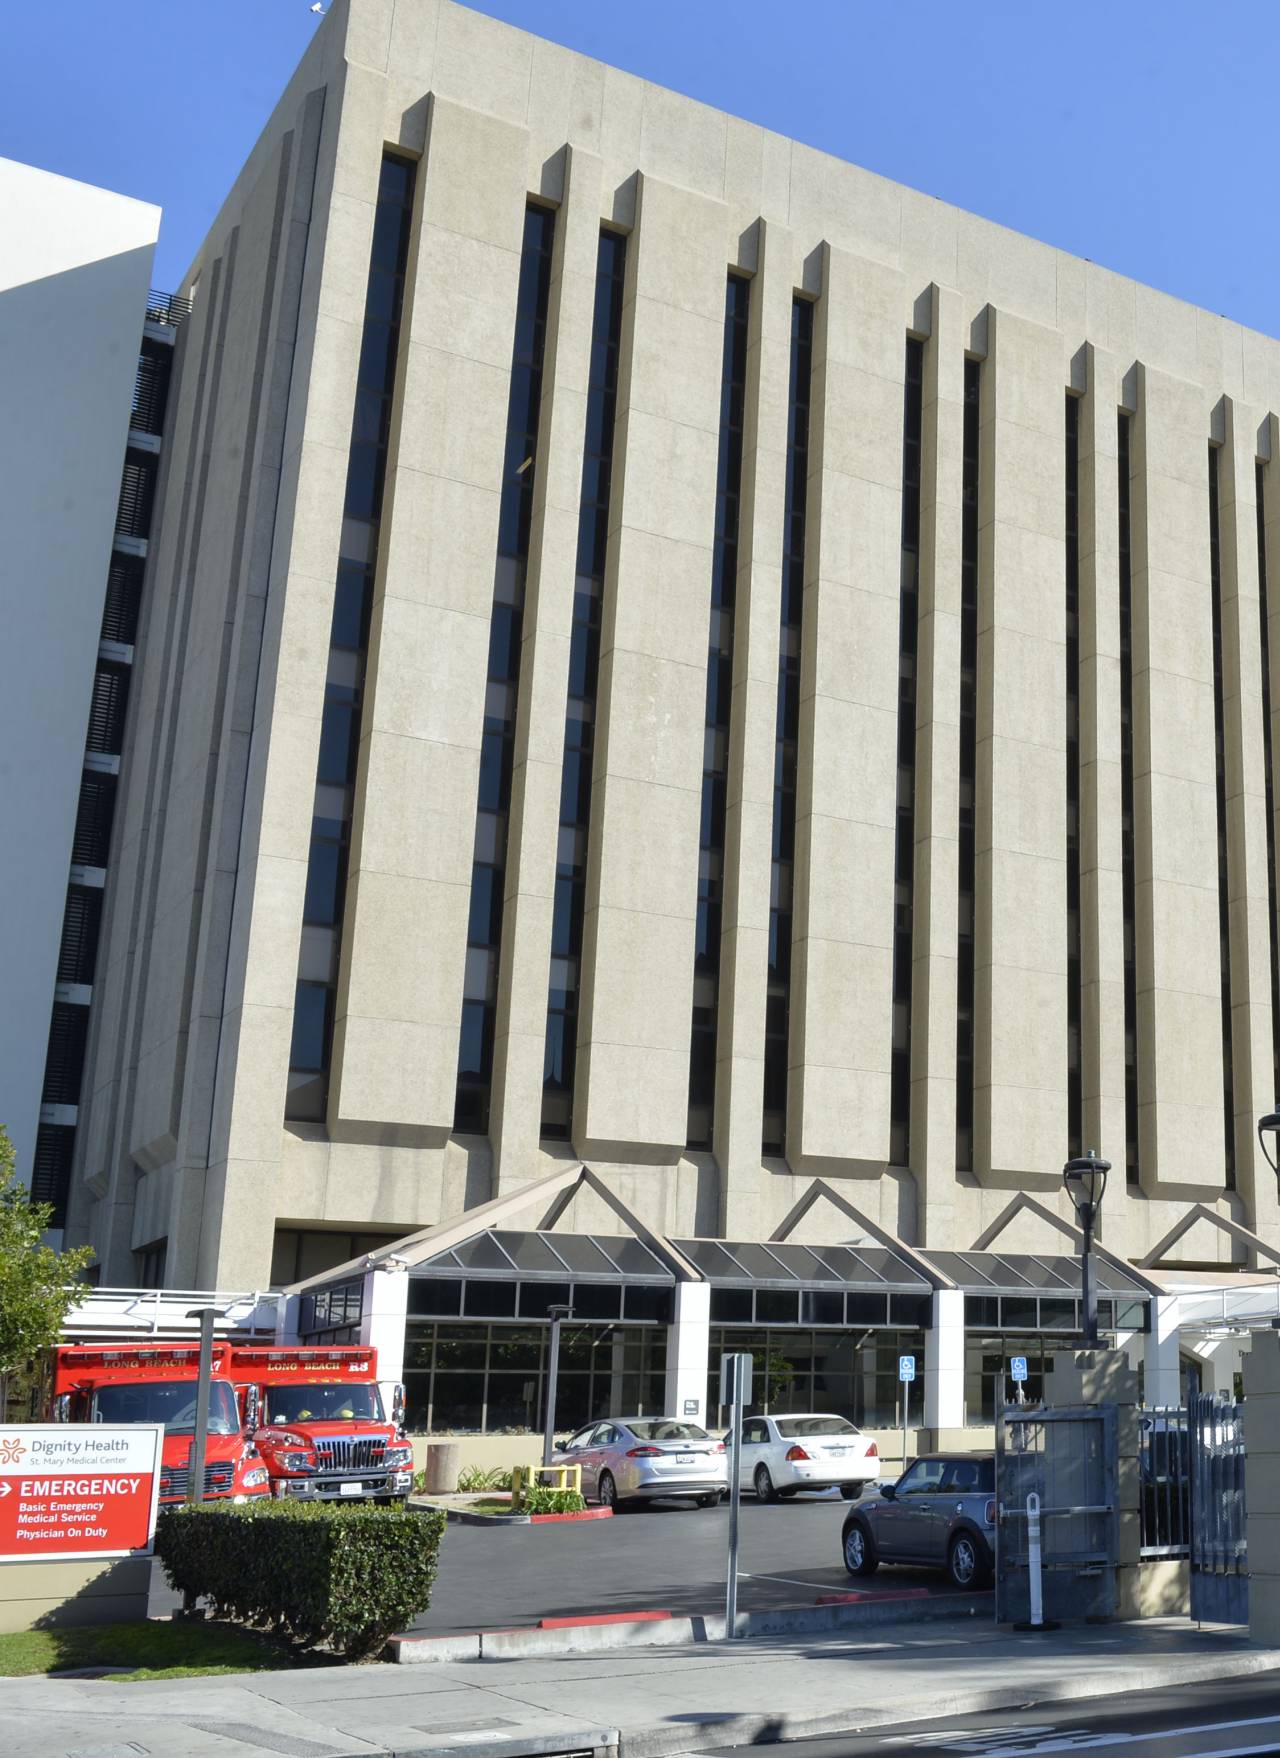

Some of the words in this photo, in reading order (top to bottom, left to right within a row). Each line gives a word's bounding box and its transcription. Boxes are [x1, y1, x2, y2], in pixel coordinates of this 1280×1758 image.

[103, 1360, 139, 1368] LONG
[267, 1363, 297, 1371] LONG
[304, 1362, 340, 1370] BEACH
[31, 1440, 81, 1455] Dignity
[85, 1439, 129, 1451] Health
[43, 1458, 64, 1467] Mary
[66, 1456, 98, 1464] Medical
[99, 1456, 127, 1464] Center
[20, 1479, 141, 1497] EMERGENCY
[19, 1503, 47, 1512] Basic
[50, 1502, 104, 1512] Emergency
[18, 1514, 58, 1523] Medical
[61, 1513, 97, 1522] Service
[16, 1529, 64, 1540] Physician
[67, 1528, 82, 1537] On
[85, 1528, 108, 1538] Duty
